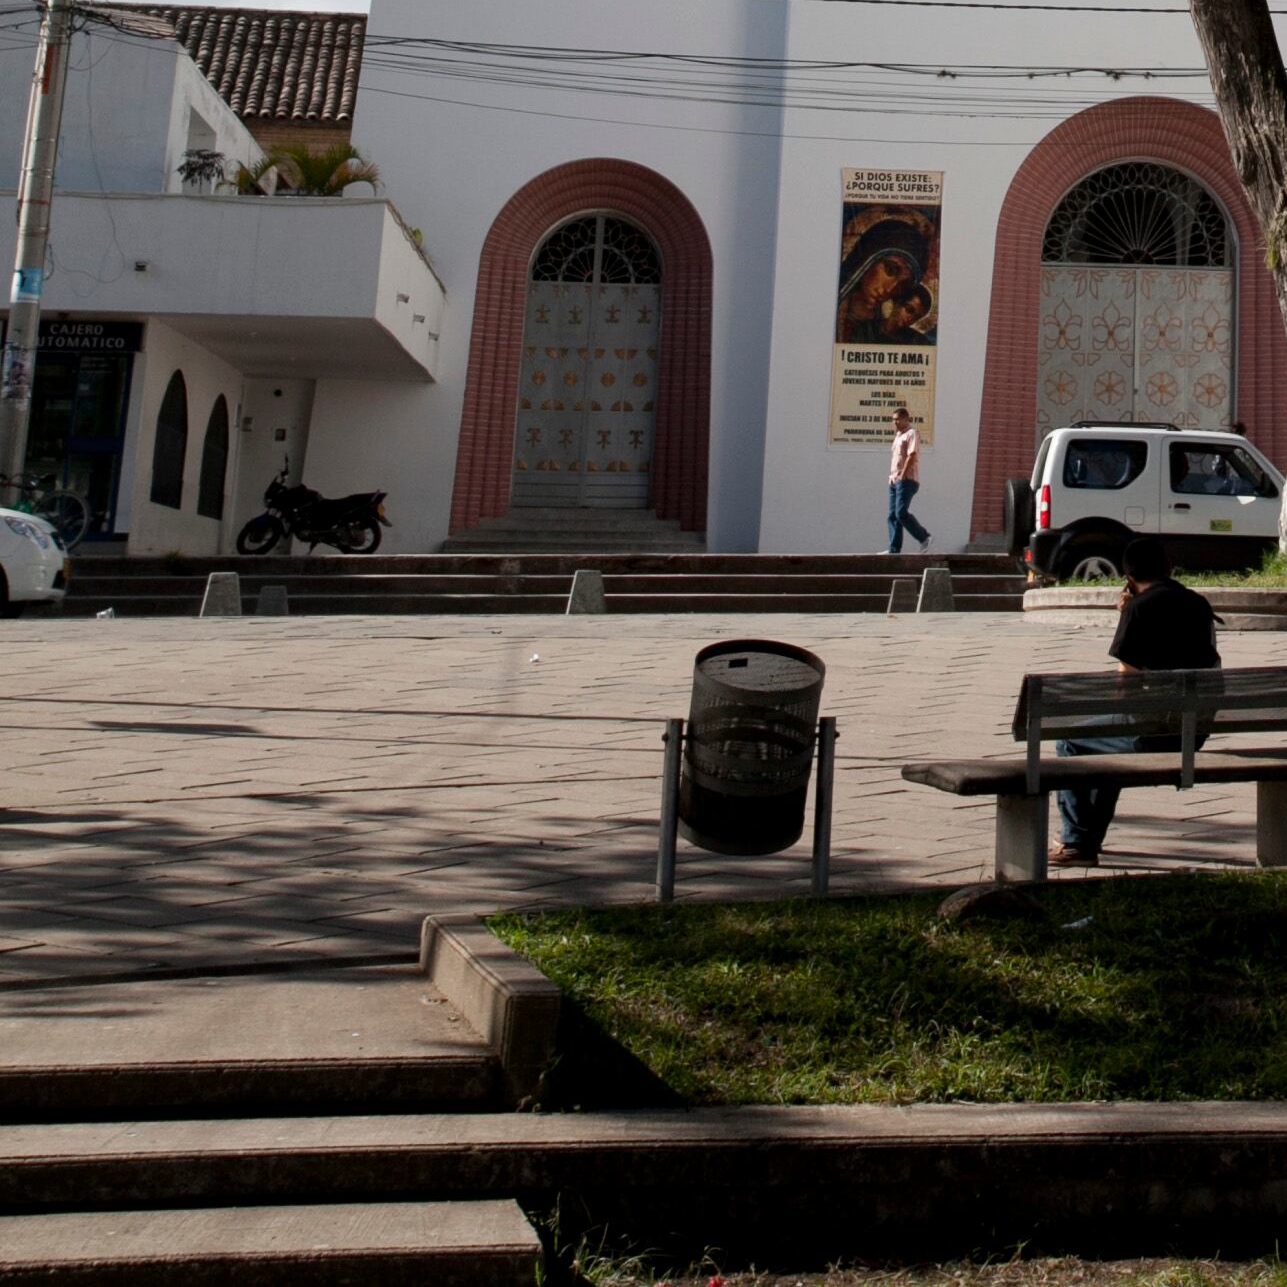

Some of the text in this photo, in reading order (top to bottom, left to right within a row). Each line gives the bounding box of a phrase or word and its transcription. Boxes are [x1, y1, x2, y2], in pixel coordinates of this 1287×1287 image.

[855, 172, 932, 183] SI DIOS EXISTE:
[846, 181, 940, 193] ¿PORQUE SUFRES?
[49, 322, 105, 336] CAJERO
[38, 335, 126, 349] UTOMATICO
[847, 351, 885, 364] CRISTO
[887, 352, 899, 364] TE
[901, 353, 923, 365] AMA
